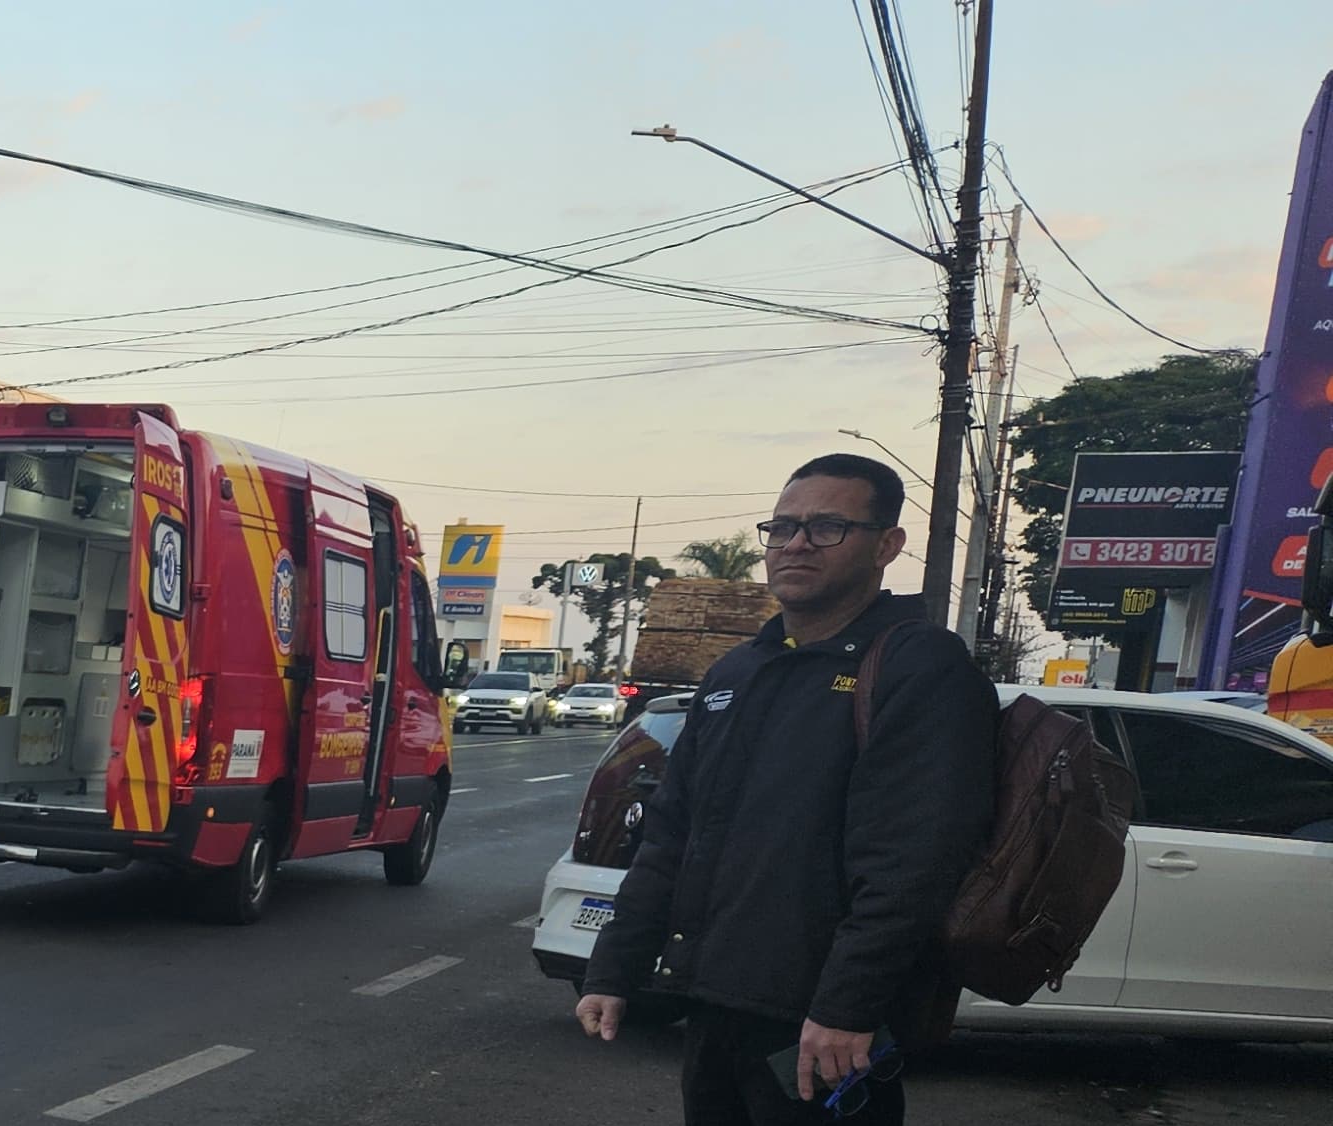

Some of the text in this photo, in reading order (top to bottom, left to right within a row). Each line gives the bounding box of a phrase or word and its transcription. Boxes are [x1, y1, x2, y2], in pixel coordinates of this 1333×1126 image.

[1313, 319, 1333, 331] AQ
[1077, 486, 1230, 503] PNEUNORTE
[1096, 542, 1216, 562] 3423 3012
